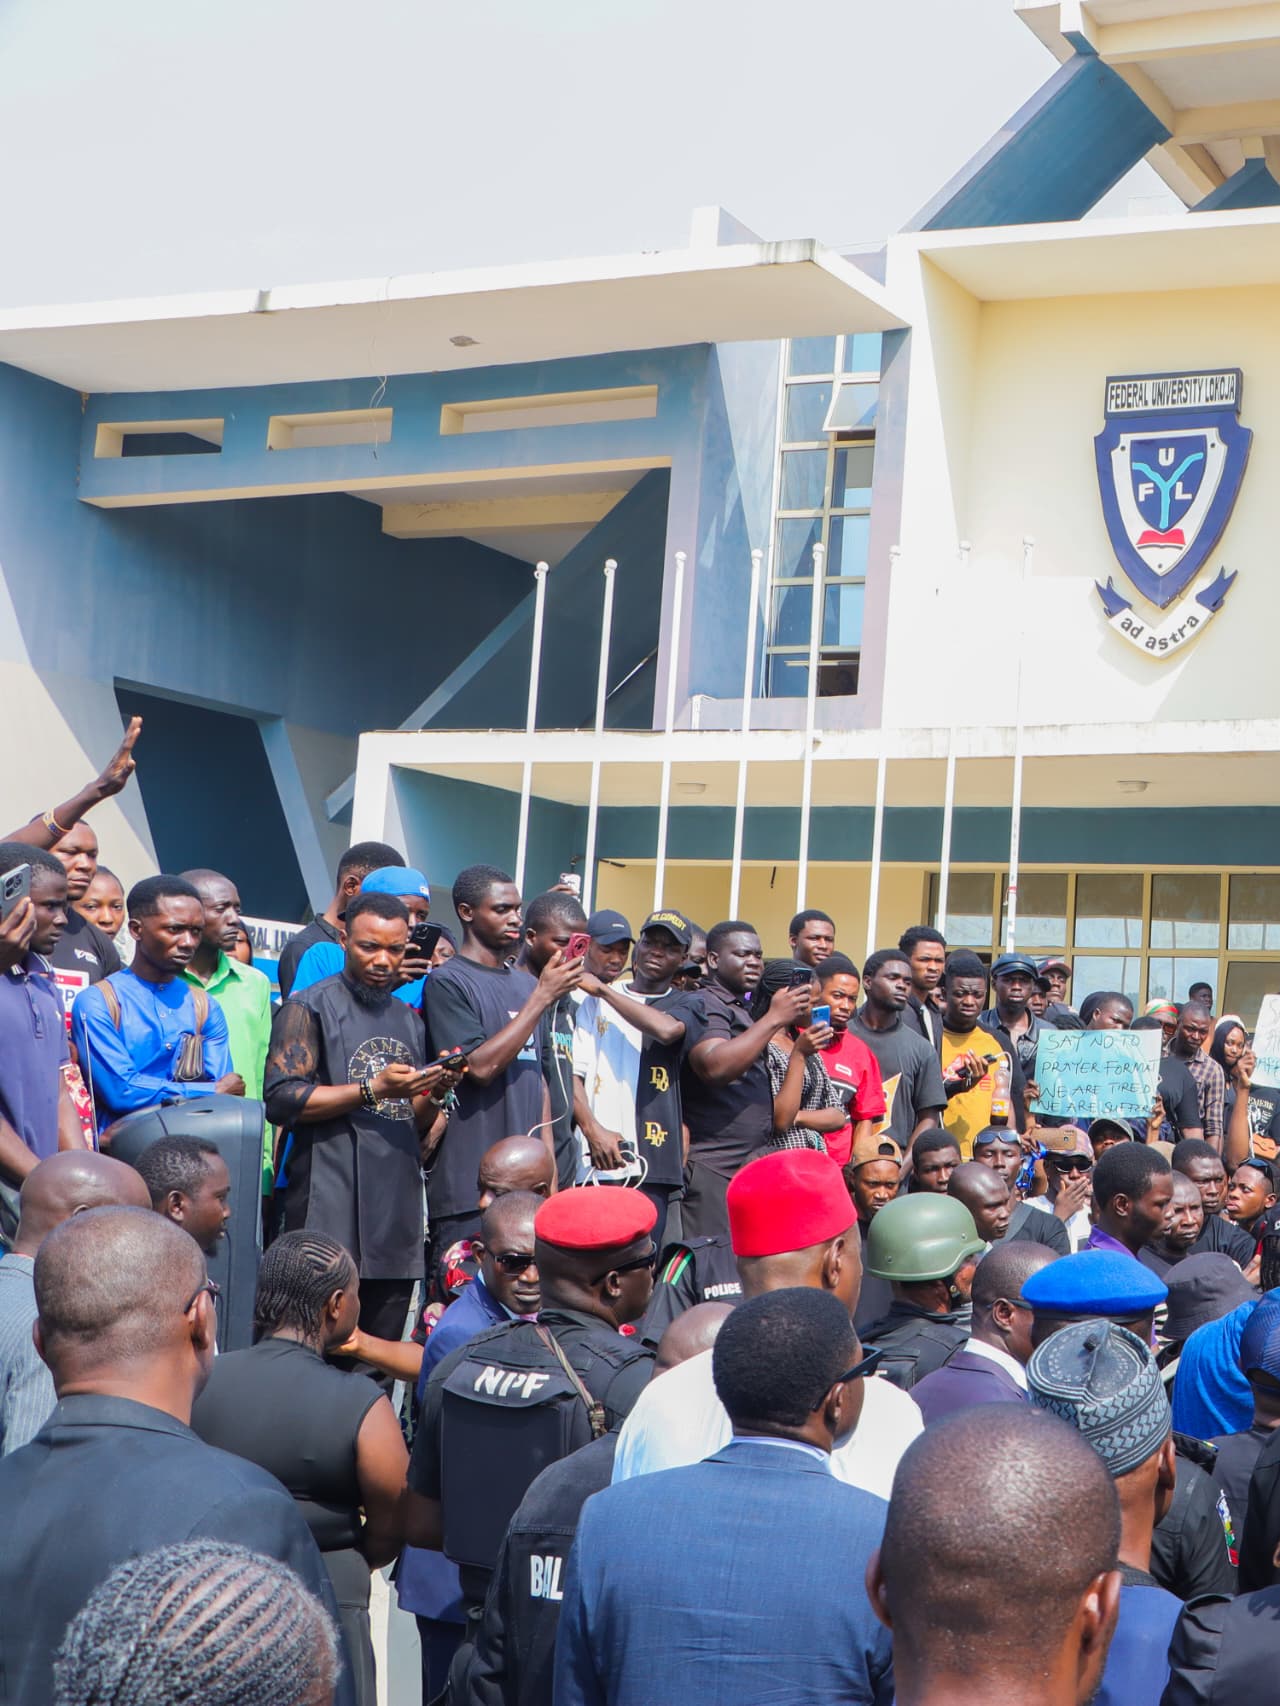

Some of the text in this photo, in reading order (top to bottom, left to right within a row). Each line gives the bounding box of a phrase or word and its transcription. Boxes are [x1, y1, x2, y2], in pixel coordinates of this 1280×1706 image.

[1109, 375, 1235, 410] FEDERAL UNIVERSITY LOKOJA
[1158, 448, 1175, 466] U
[1138, 481, 1192, 502] F L
[1120, 614, 1200, 651] ad astra
[1045, 1030, 1141, 1053] SAY NO TO
[1041, 1059, 1160, 1077] PRAYER FORMAT
[1039, 1081, 1152, 1099] WE ARE TIRED
[1037, 1099, 1061, 1113] WE
[1066, 1099, 1098, 1114] ARE
[703, 1282, 742, 1300] POLICE
[473, 1365, 552, 1399] NPF
